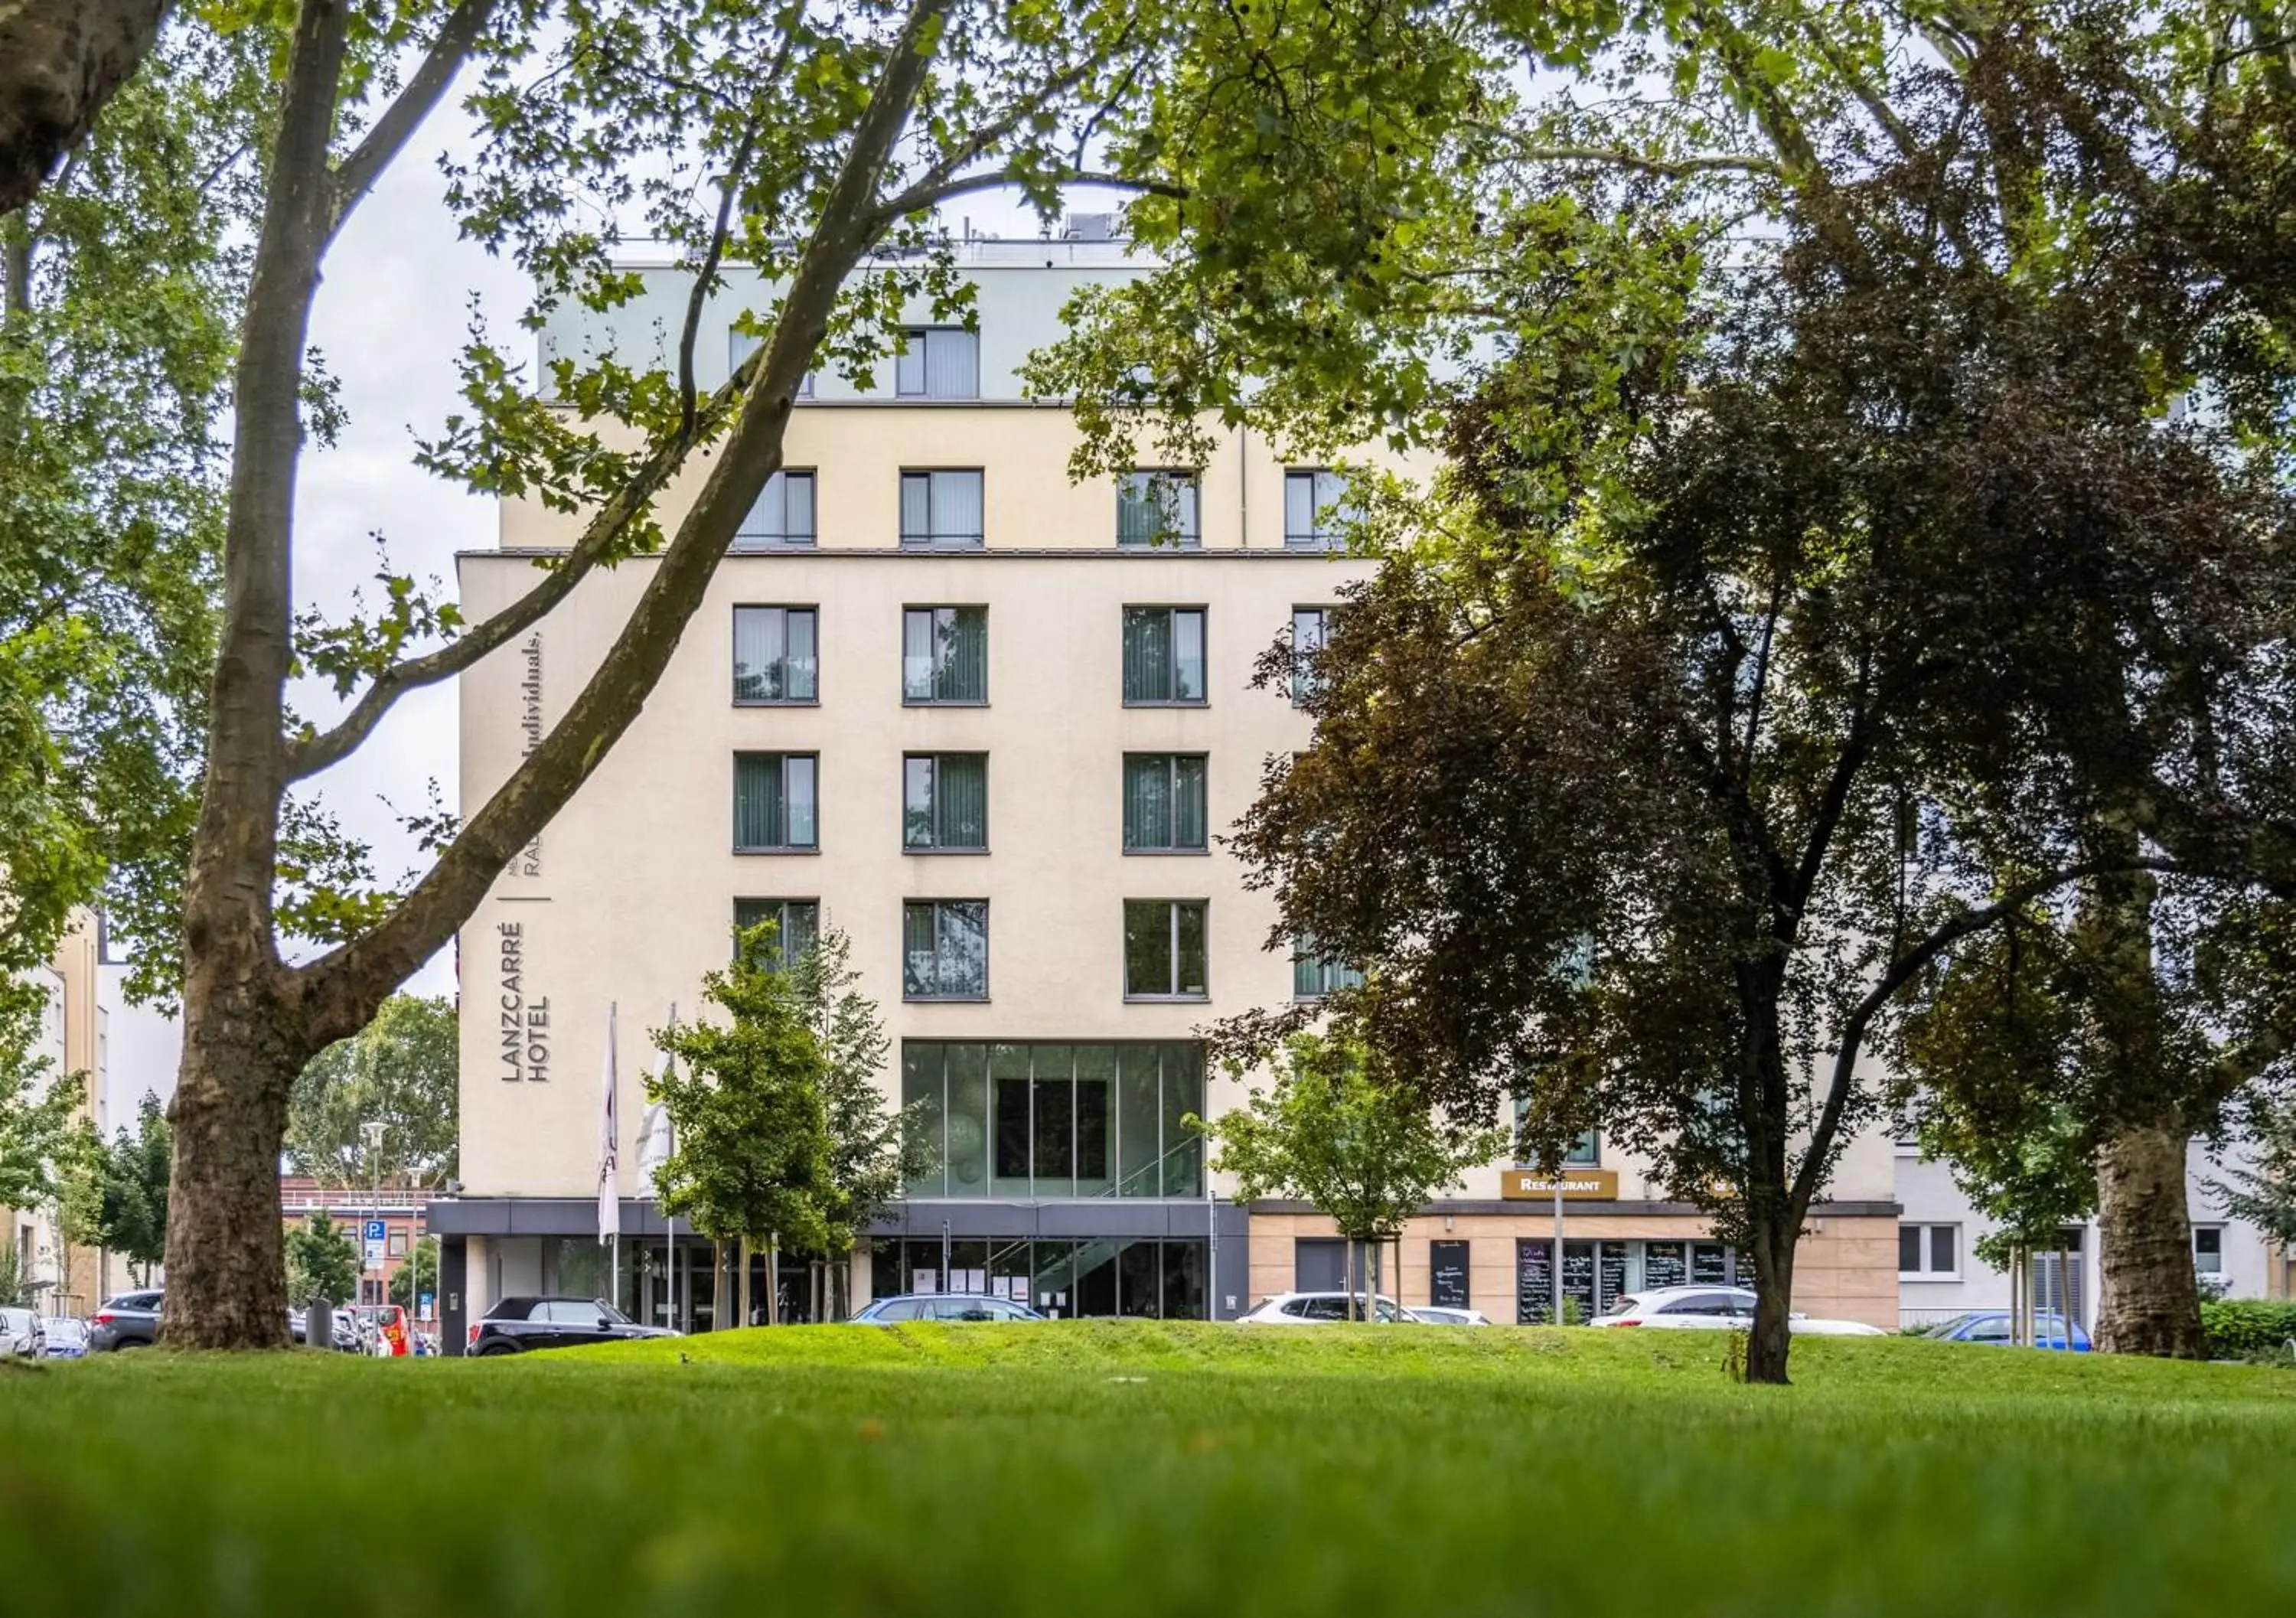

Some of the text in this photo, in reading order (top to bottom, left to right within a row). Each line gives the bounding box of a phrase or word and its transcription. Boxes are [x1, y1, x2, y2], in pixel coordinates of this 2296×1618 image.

[497, 922, 520, 1081] LANZCARRÉ
[528, 996, 547, 1081] HOTEL
[368, 1222, 380, 1238] P
